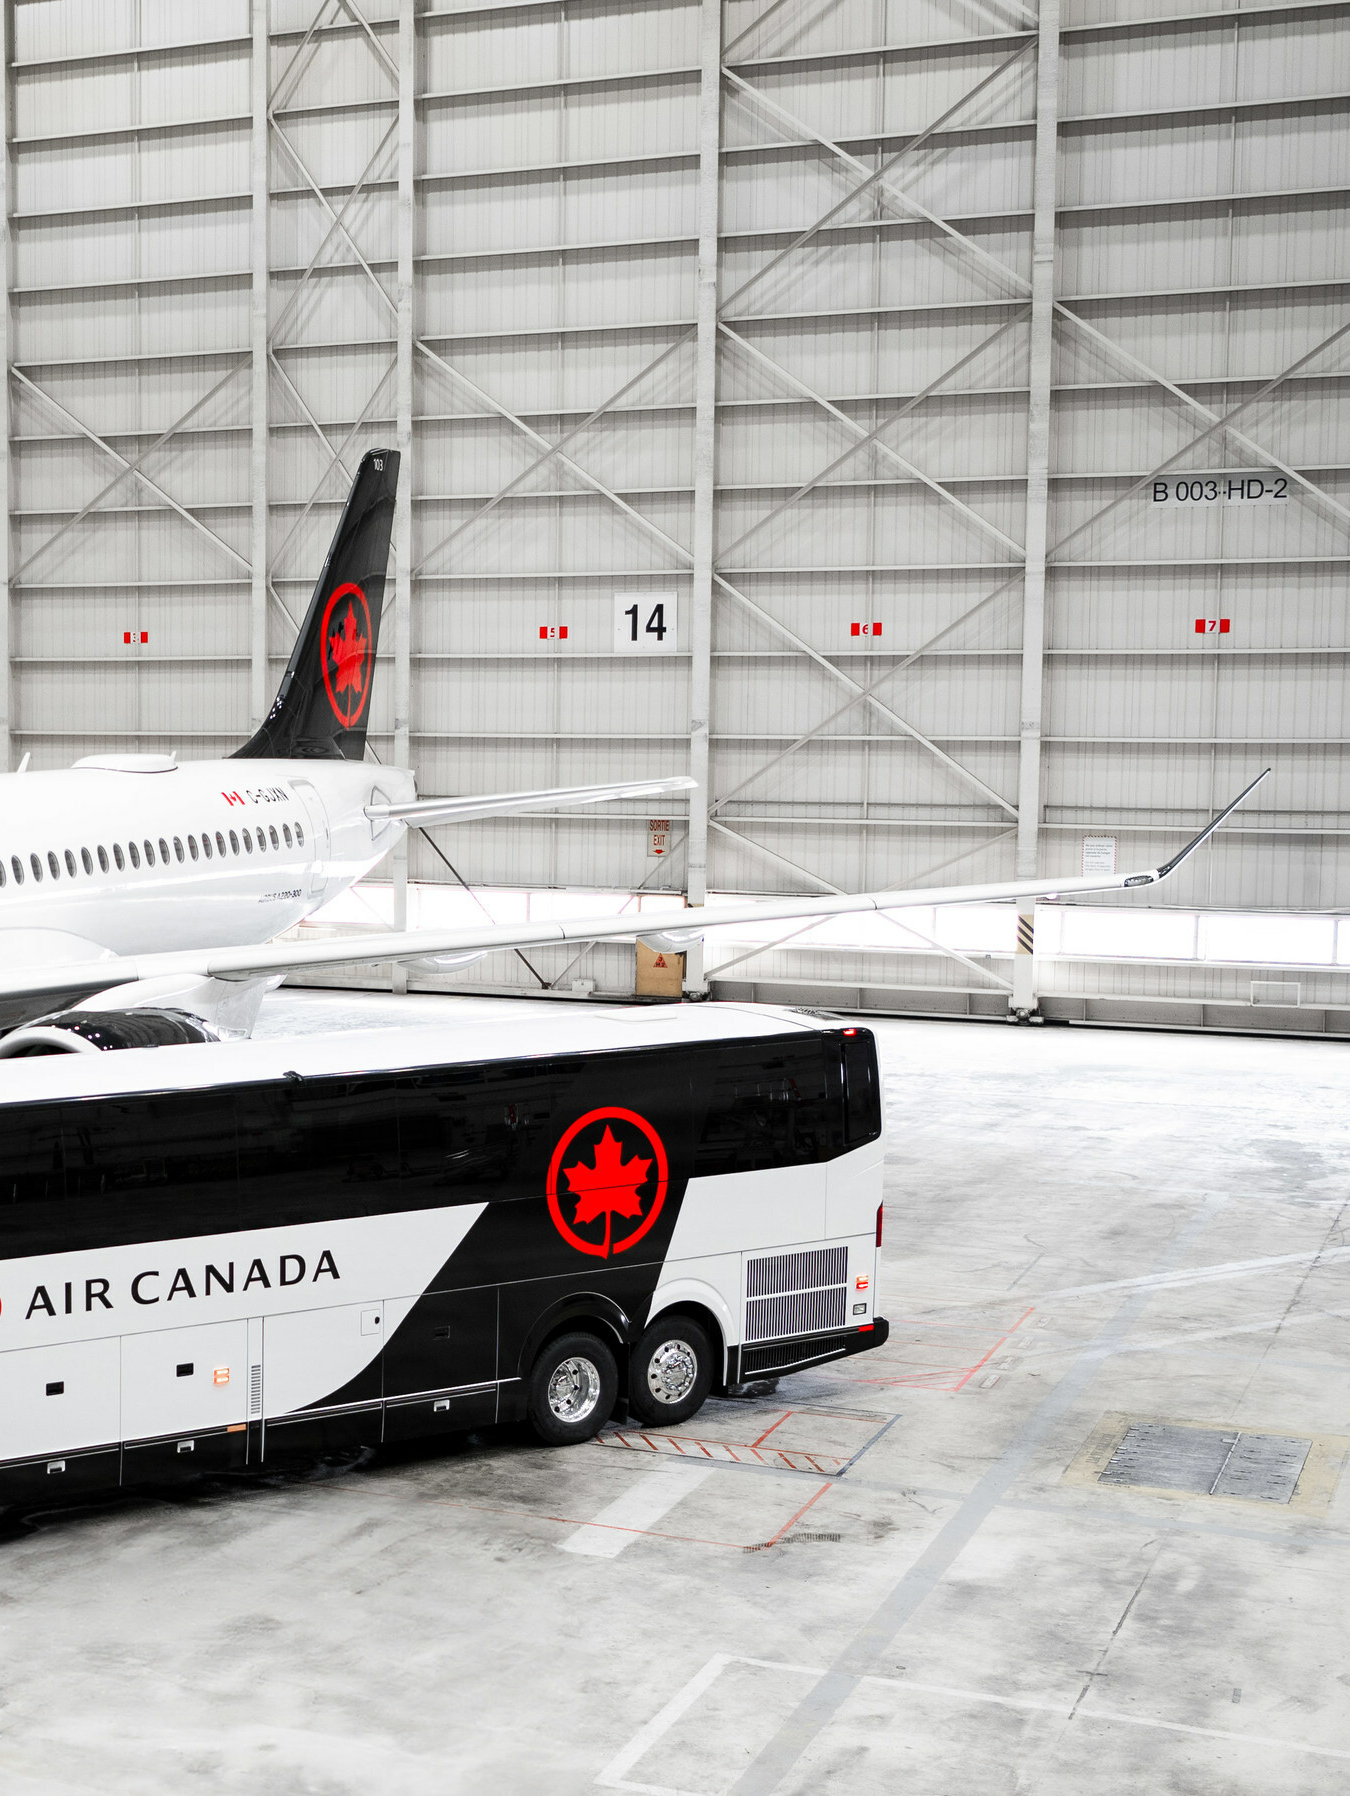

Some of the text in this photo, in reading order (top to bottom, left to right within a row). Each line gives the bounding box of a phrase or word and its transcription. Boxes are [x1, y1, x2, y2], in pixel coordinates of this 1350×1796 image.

[373, 458, 384, 471] 103
[1153, 482, 1169, 502] B
[624, 603, 667, 641] 14
[1208, 620, 1217, 632] 7
[862, 623, 869, 635] 6
[650, 819, 670, 832] SORTIE
[653, 834, 666, 846] EXIT
[25, 1249, 340, 1320] AIR CANADA
